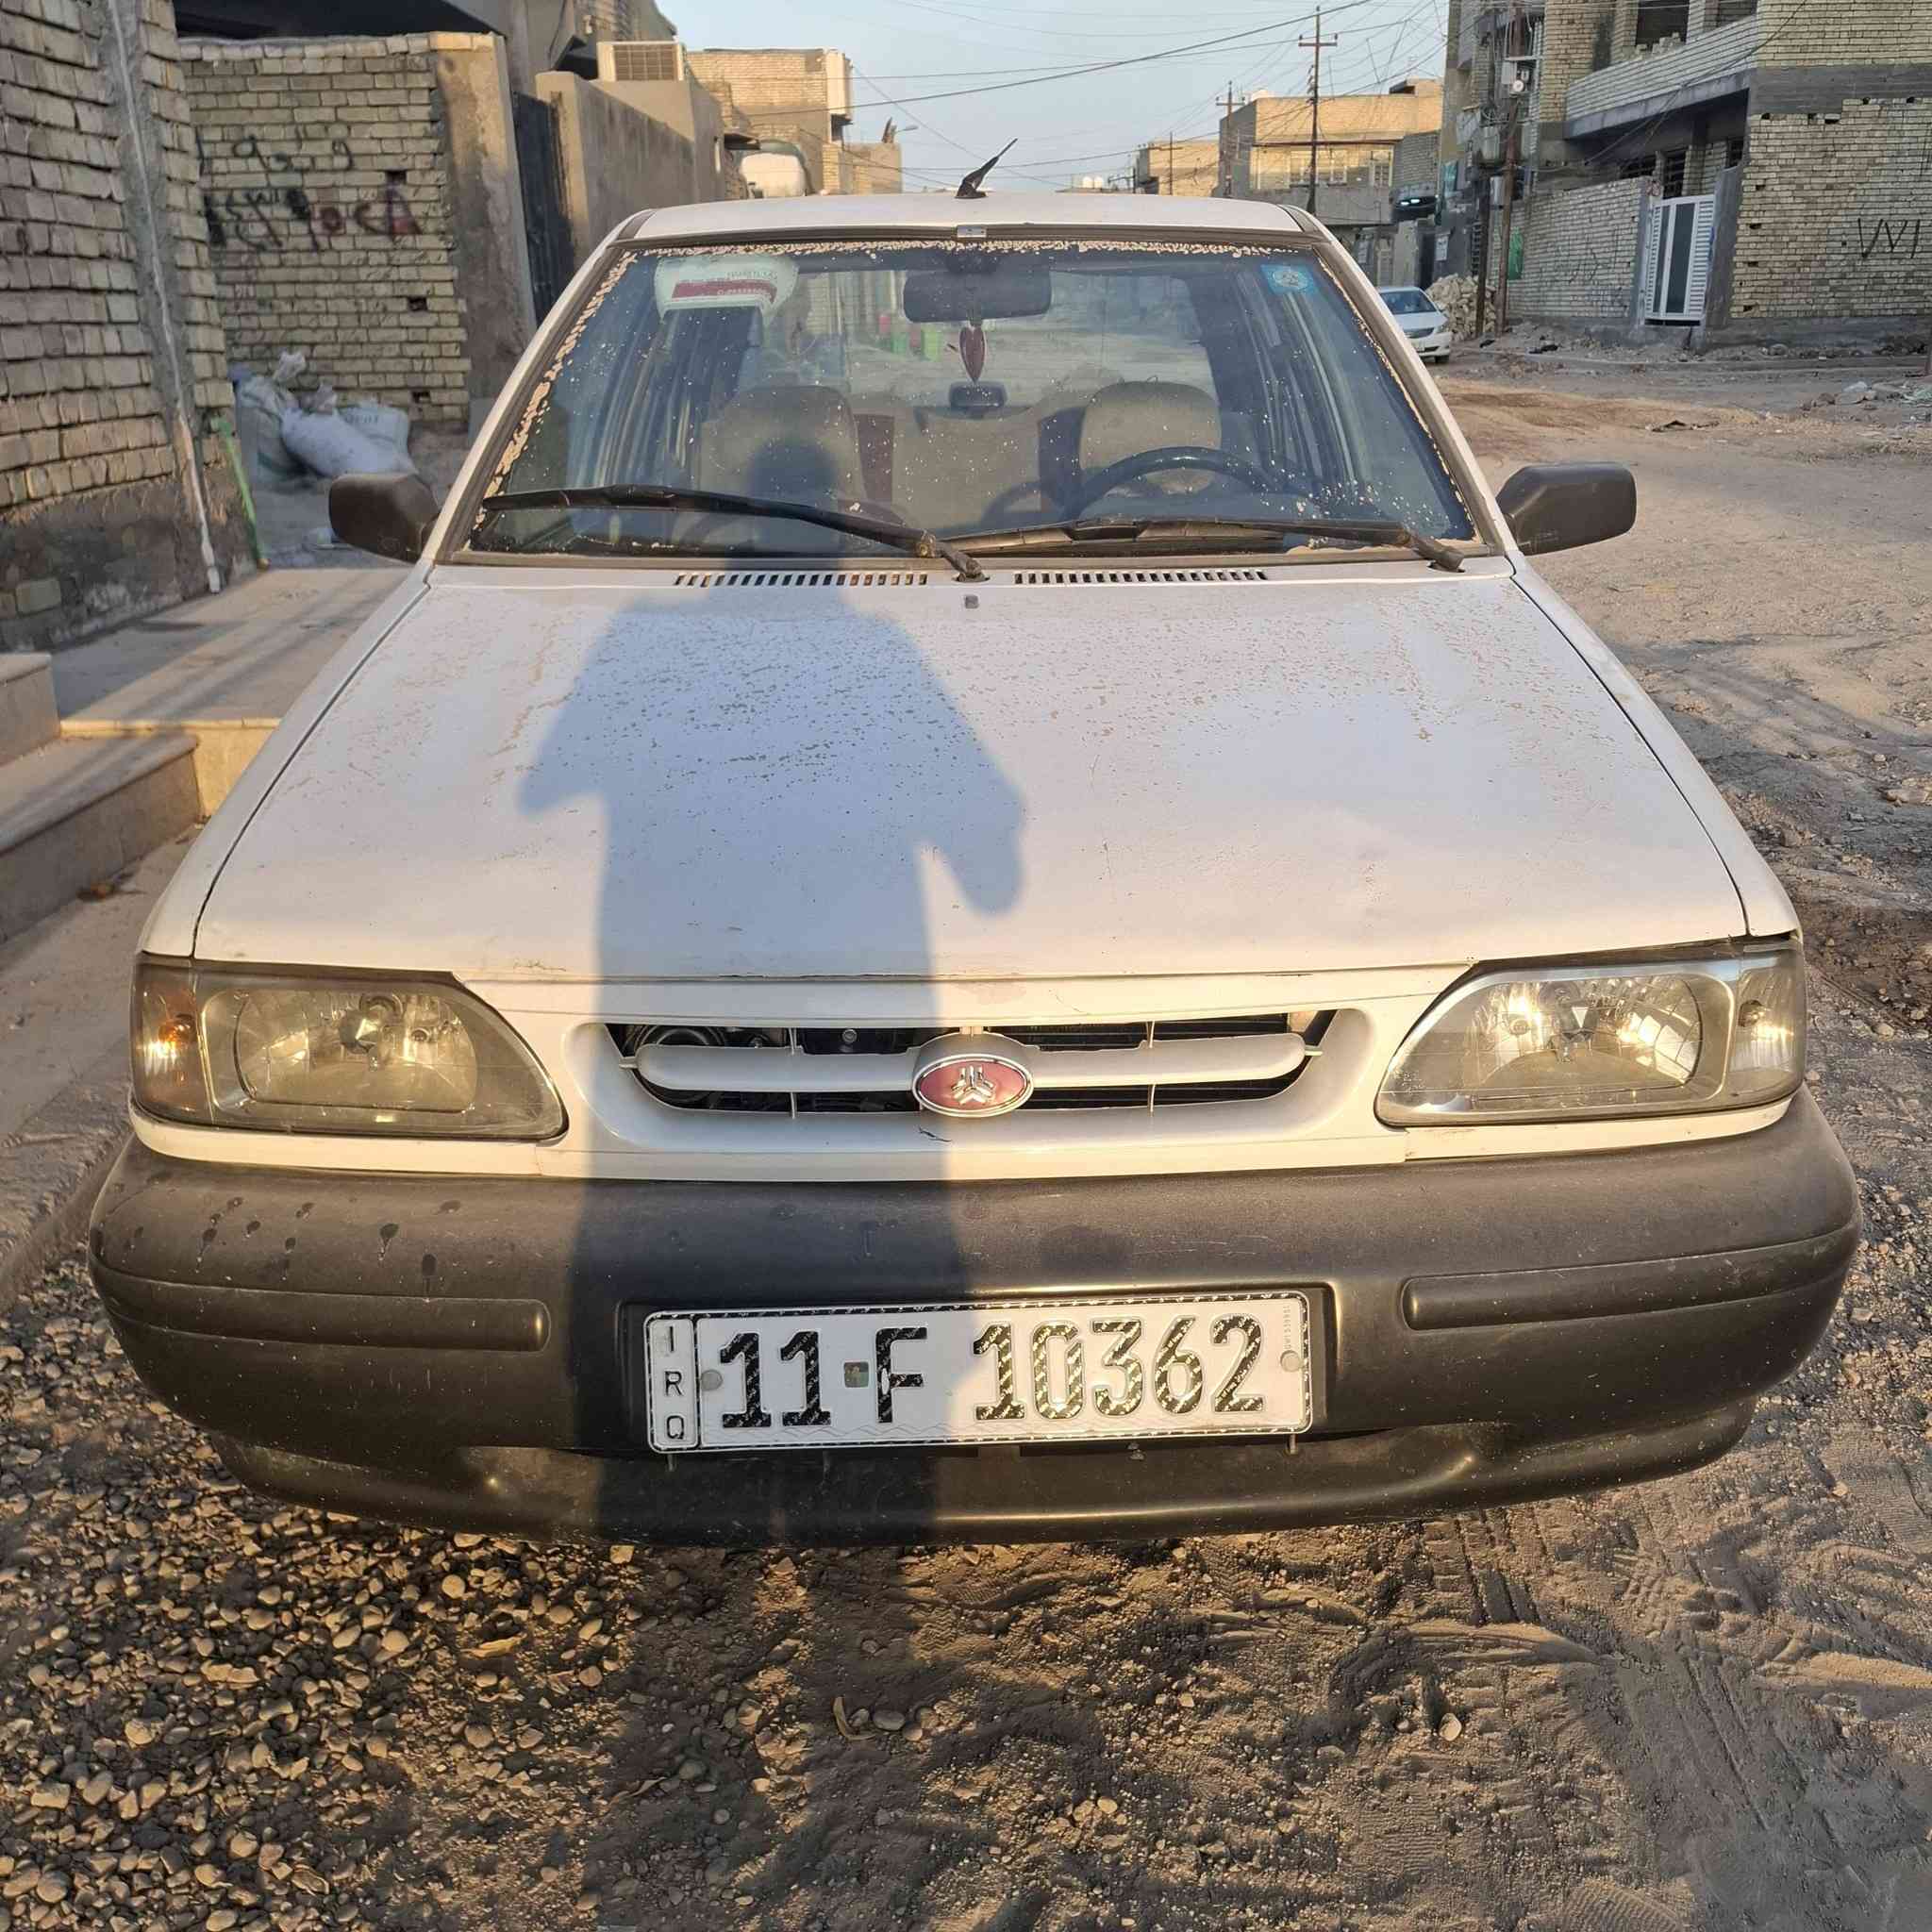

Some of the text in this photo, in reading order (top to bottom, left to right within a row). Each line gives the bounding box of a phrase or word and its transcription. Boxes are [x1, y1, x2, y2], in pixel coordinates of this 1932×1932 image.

[720, 1331, 831, 1427] 11
[875, 1327, 927, 1423] F
[973, 1314, 1264, 1420] 10362
